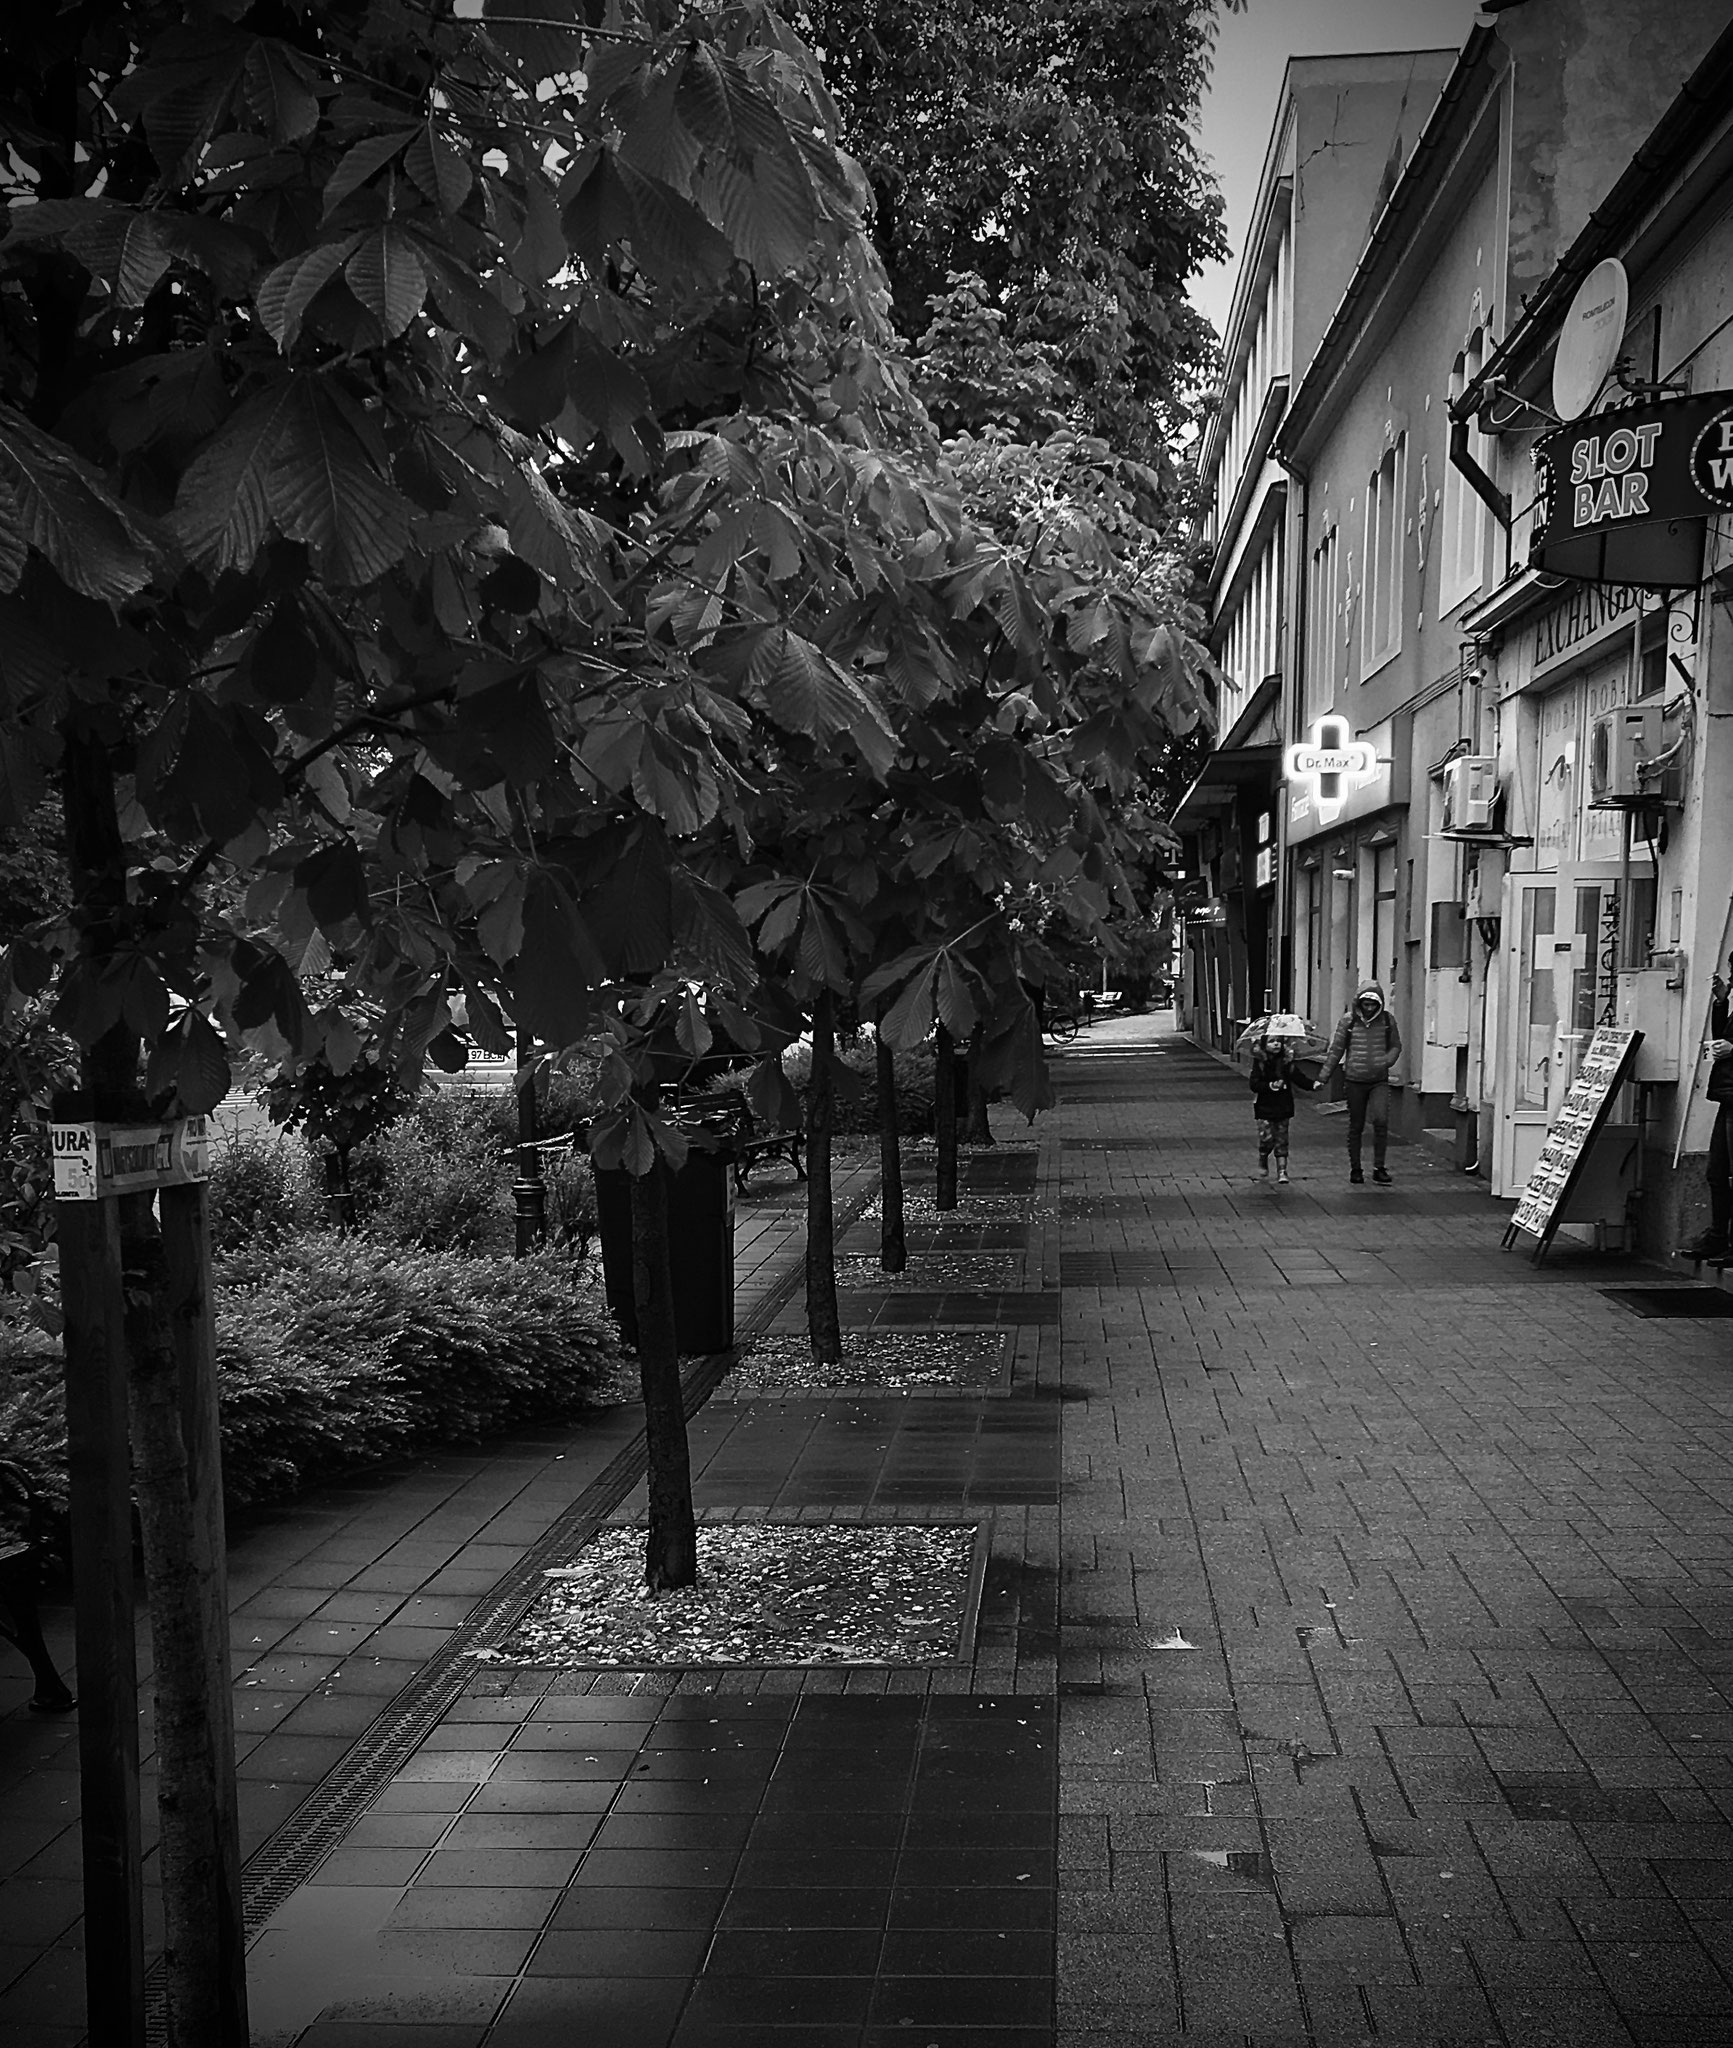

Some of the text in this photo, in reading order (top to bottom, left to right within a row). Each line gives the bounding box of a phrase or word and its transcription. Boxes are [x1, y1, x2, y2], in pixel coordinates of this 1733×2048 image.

[1570, 421, 1662, 484] SLOT
[1573, 472, 1650, 528] BAR
[471, 1050, 482, 1059] 97
[53, 1131, 90, 1151] URA
